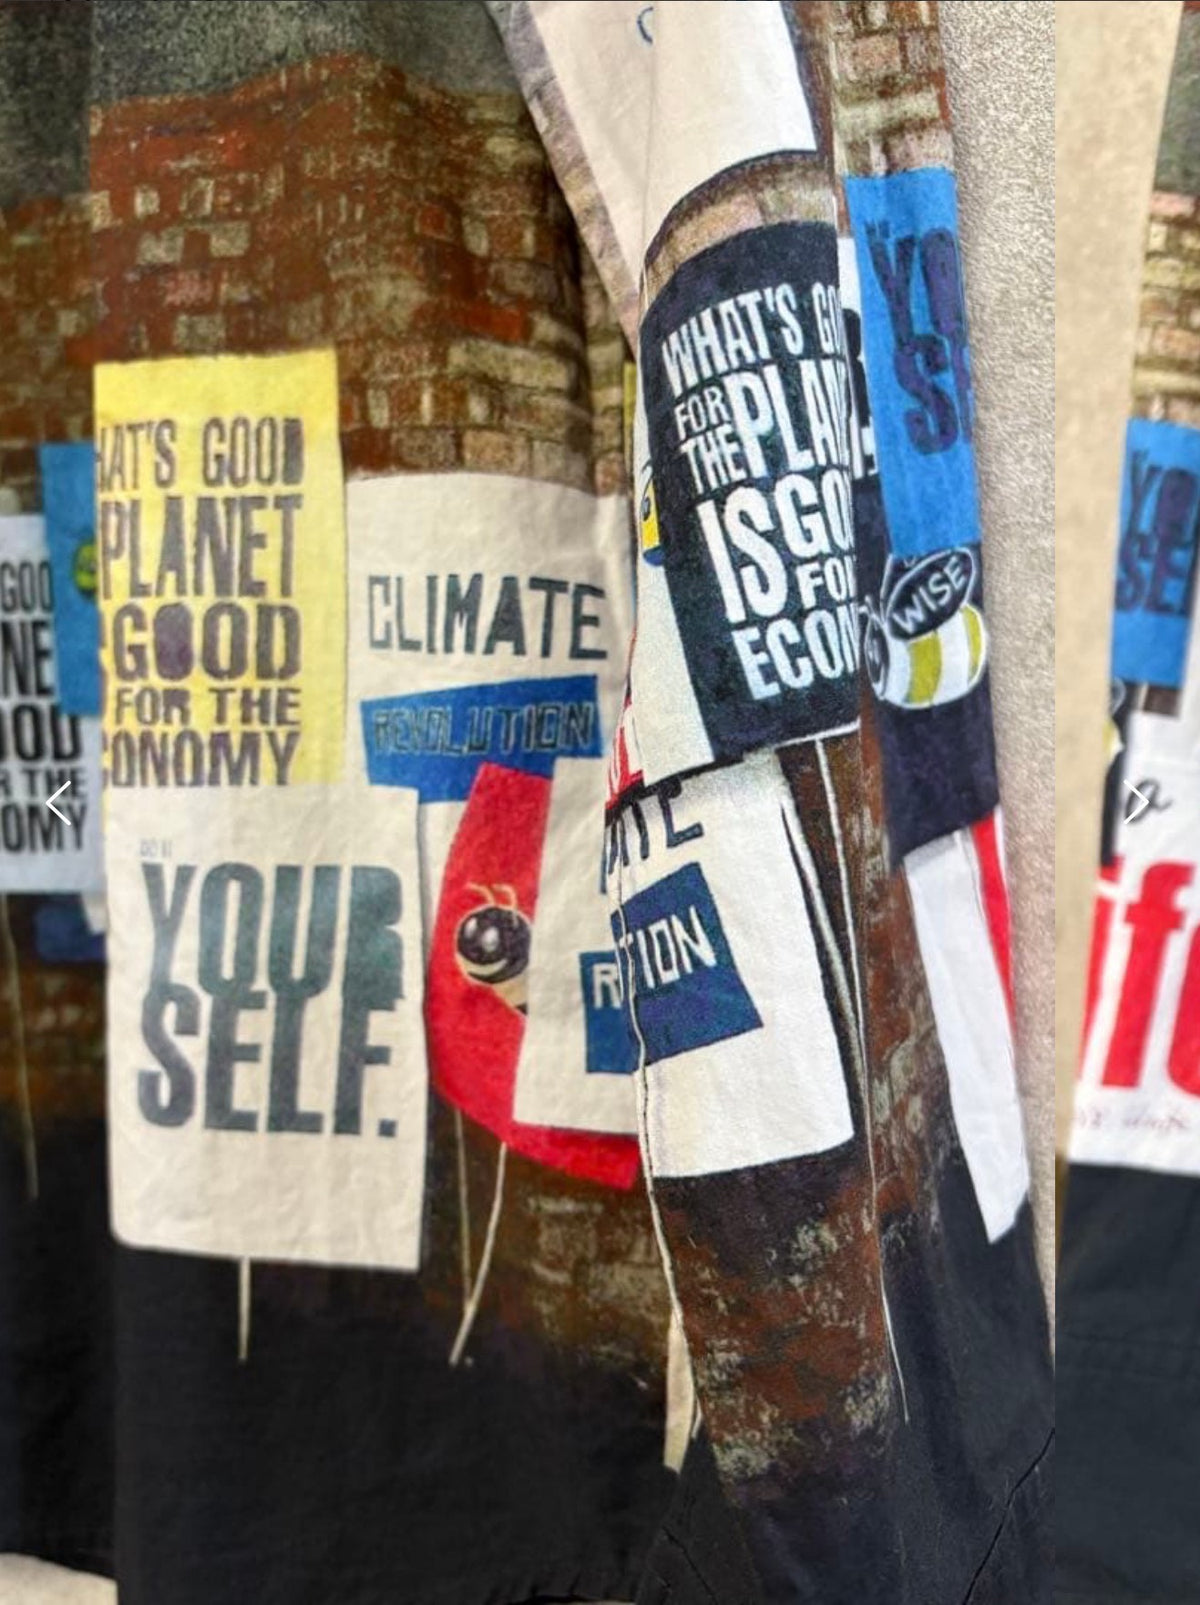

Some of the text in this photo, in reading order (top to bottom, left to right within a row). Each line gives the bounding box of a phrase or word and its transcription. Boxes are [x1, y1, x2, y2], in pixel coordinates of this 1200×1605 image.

[662, 282, 804, 397] WHAT'S
[202, 416, 305, 488] GOOD
[674, 385, 732, 440] FOR
[680, 423, 743, 494] THE
[101, 495, 304, 600] PLANET
[696, 486, 788, 624] IS
[368, 573, 608, 660] CLIMATE
[891, 555, 967, 636] WISE
[112, 602, 302, 682] GOOD
[115, 686, 302, 727] FOR THE
[374, 701, 594, 756] REVOLUTION
[22, 768, 87, 799] THE
[140, 862, 406, 1000] YOUR
[138, 982, 398, 1138] SELF.
